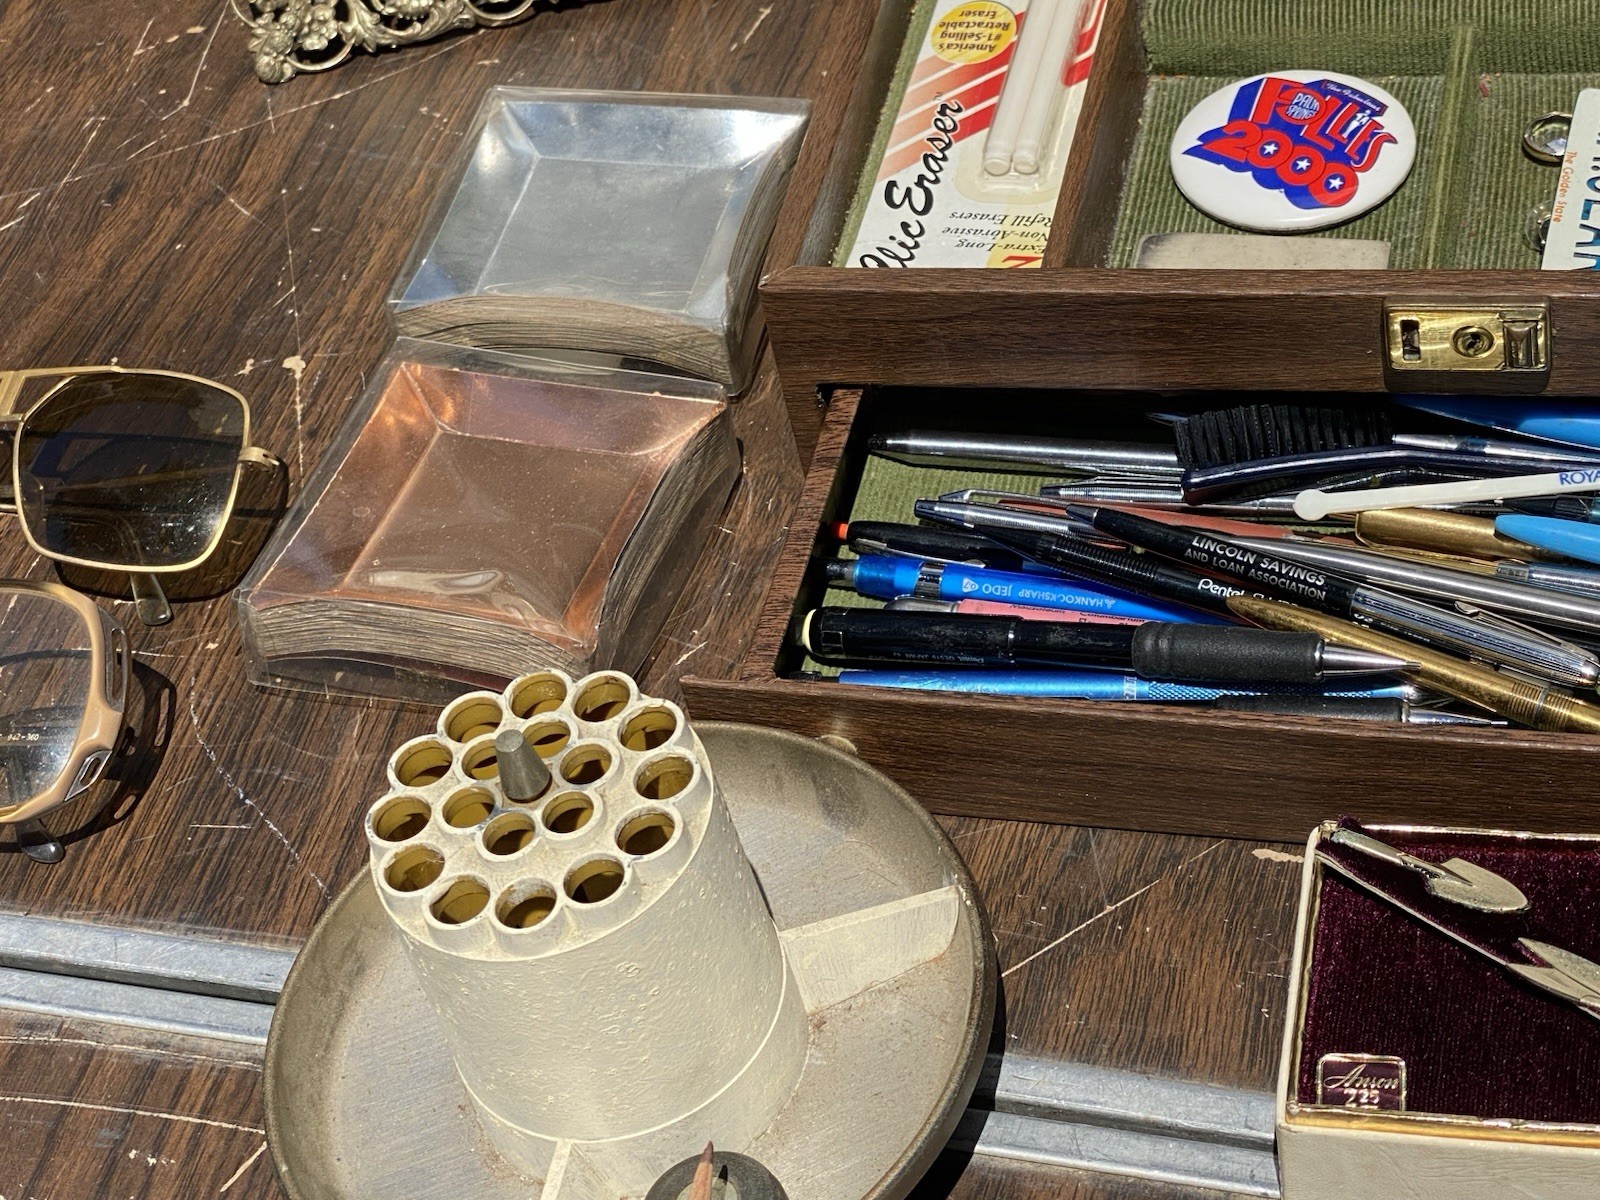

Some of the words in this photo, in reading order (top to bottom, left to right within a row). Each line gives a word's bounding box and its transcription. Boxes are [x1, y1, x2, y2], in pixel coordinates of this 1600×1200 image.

[958, 10, 997, 19] Eraser
[939, 21, 1010, 31] Retractable
[940, 31, 1002, 42] #1-Selling
[938, 43, 997, 53] America's
[1292, 92, 1320, 111] PALM
[1286, 104, 1318, 120] SPRINGS
[884, 99, 964, 217] Eraser
[1203, 119, 1359, 207] 2000
[1565, 151, 1577, 164] The
[1558, 166, 1574, 198] Golden
[949, 211, 1010, 225] Erasers
[1552, 201, 1567, 223] State
[1010, 213, 1052, 228] Refill
[1192, 535, 1257, 564] LINCOLN
[1260, 557, 1326, 586] SAVINGS
[1184, 548, 1209, 563] AND
[1212, 556, 1245, 575] LOAN
[1248, 568, 1326, 601] ASSOCIATION
[982, 583, 1013, 597] JEDO
[1323, 1063, 1400, 1090] Anson
